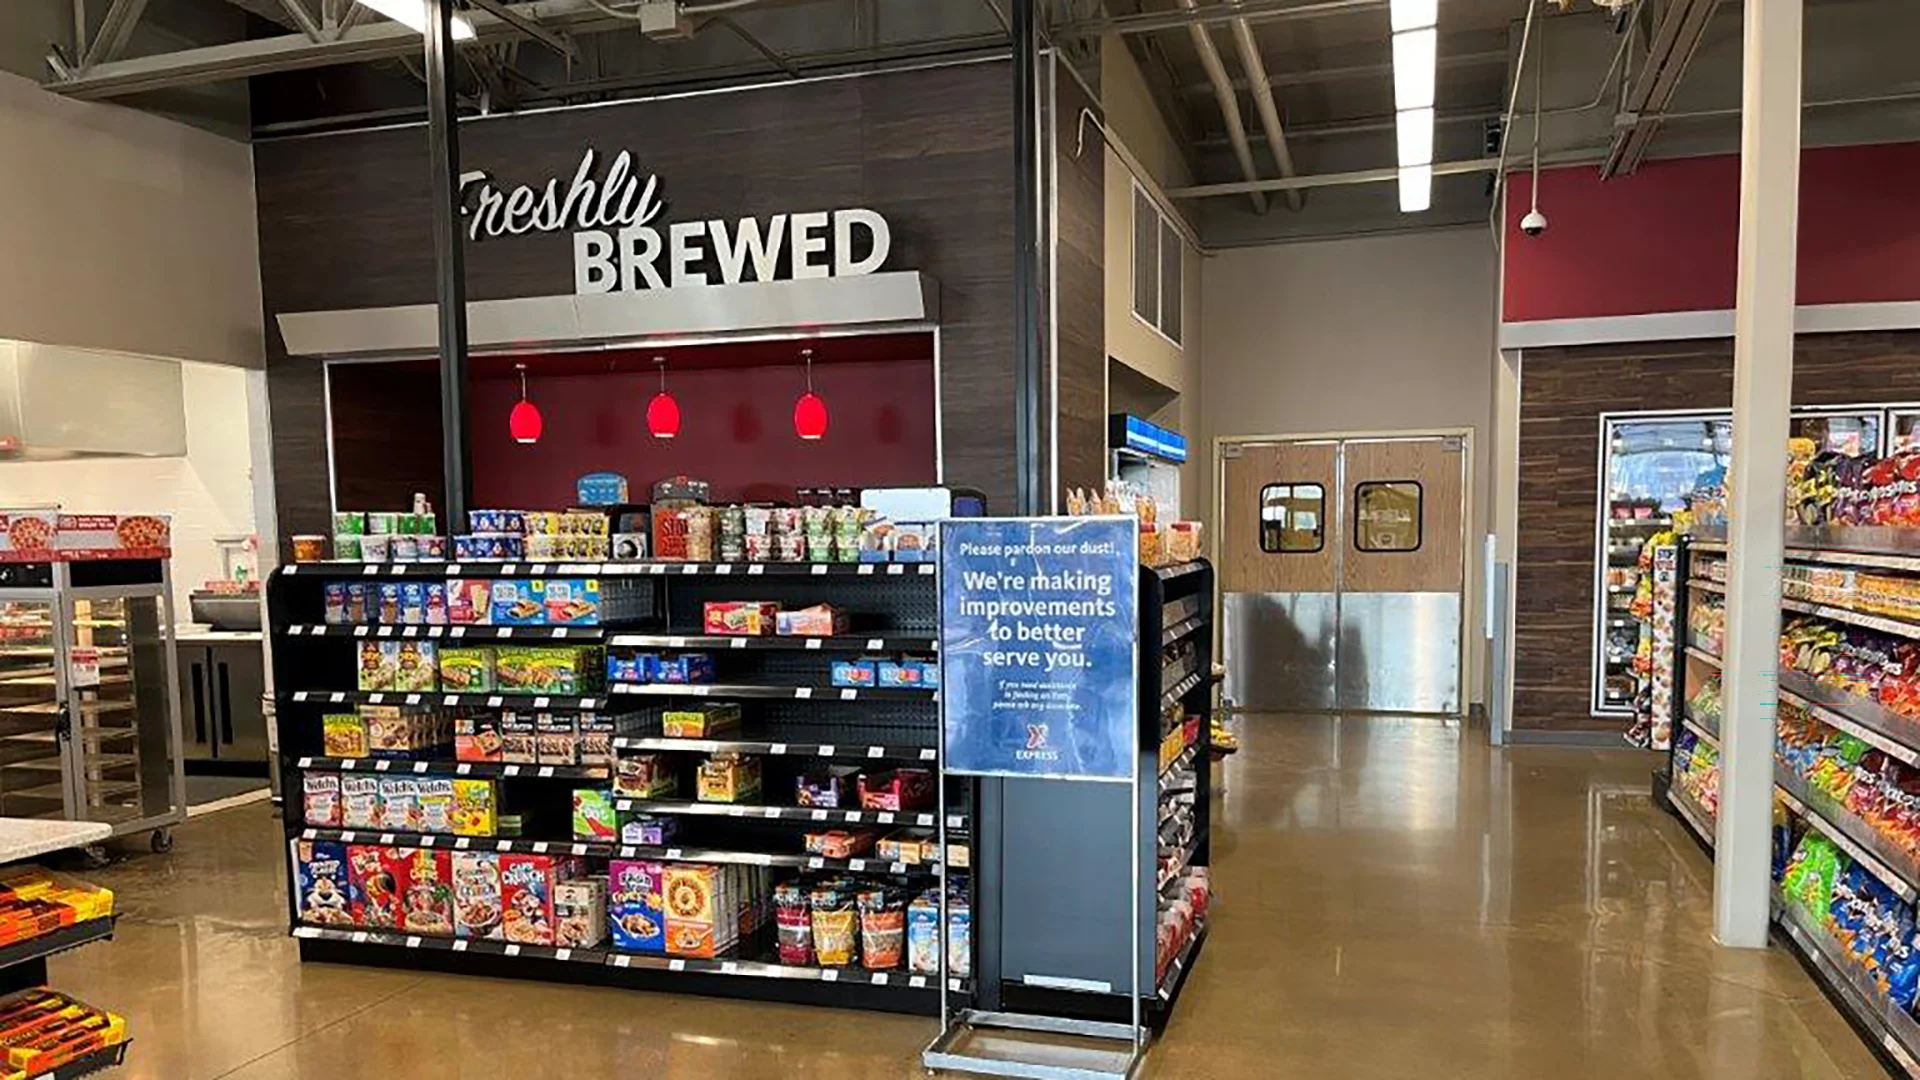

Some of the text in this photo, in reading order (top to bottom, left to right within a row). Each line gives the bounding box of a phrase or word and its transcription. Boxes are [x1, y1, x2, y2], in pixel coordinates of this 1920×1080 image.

[574, 208, 891, 295] BREWED
[959, 542, 1002, 556] Please
[1004, 543, 1050, 558] pardon
[1053, 545, 1077, 555] our
[963, 569, 1112, 596] We're making
[960, 596, 1116, 621] improvements
[990, 620, 1086, 641] to better
[983, 651, 1092, 672] serve you.
[1016, 750, 1058, 760] EXPRESS
